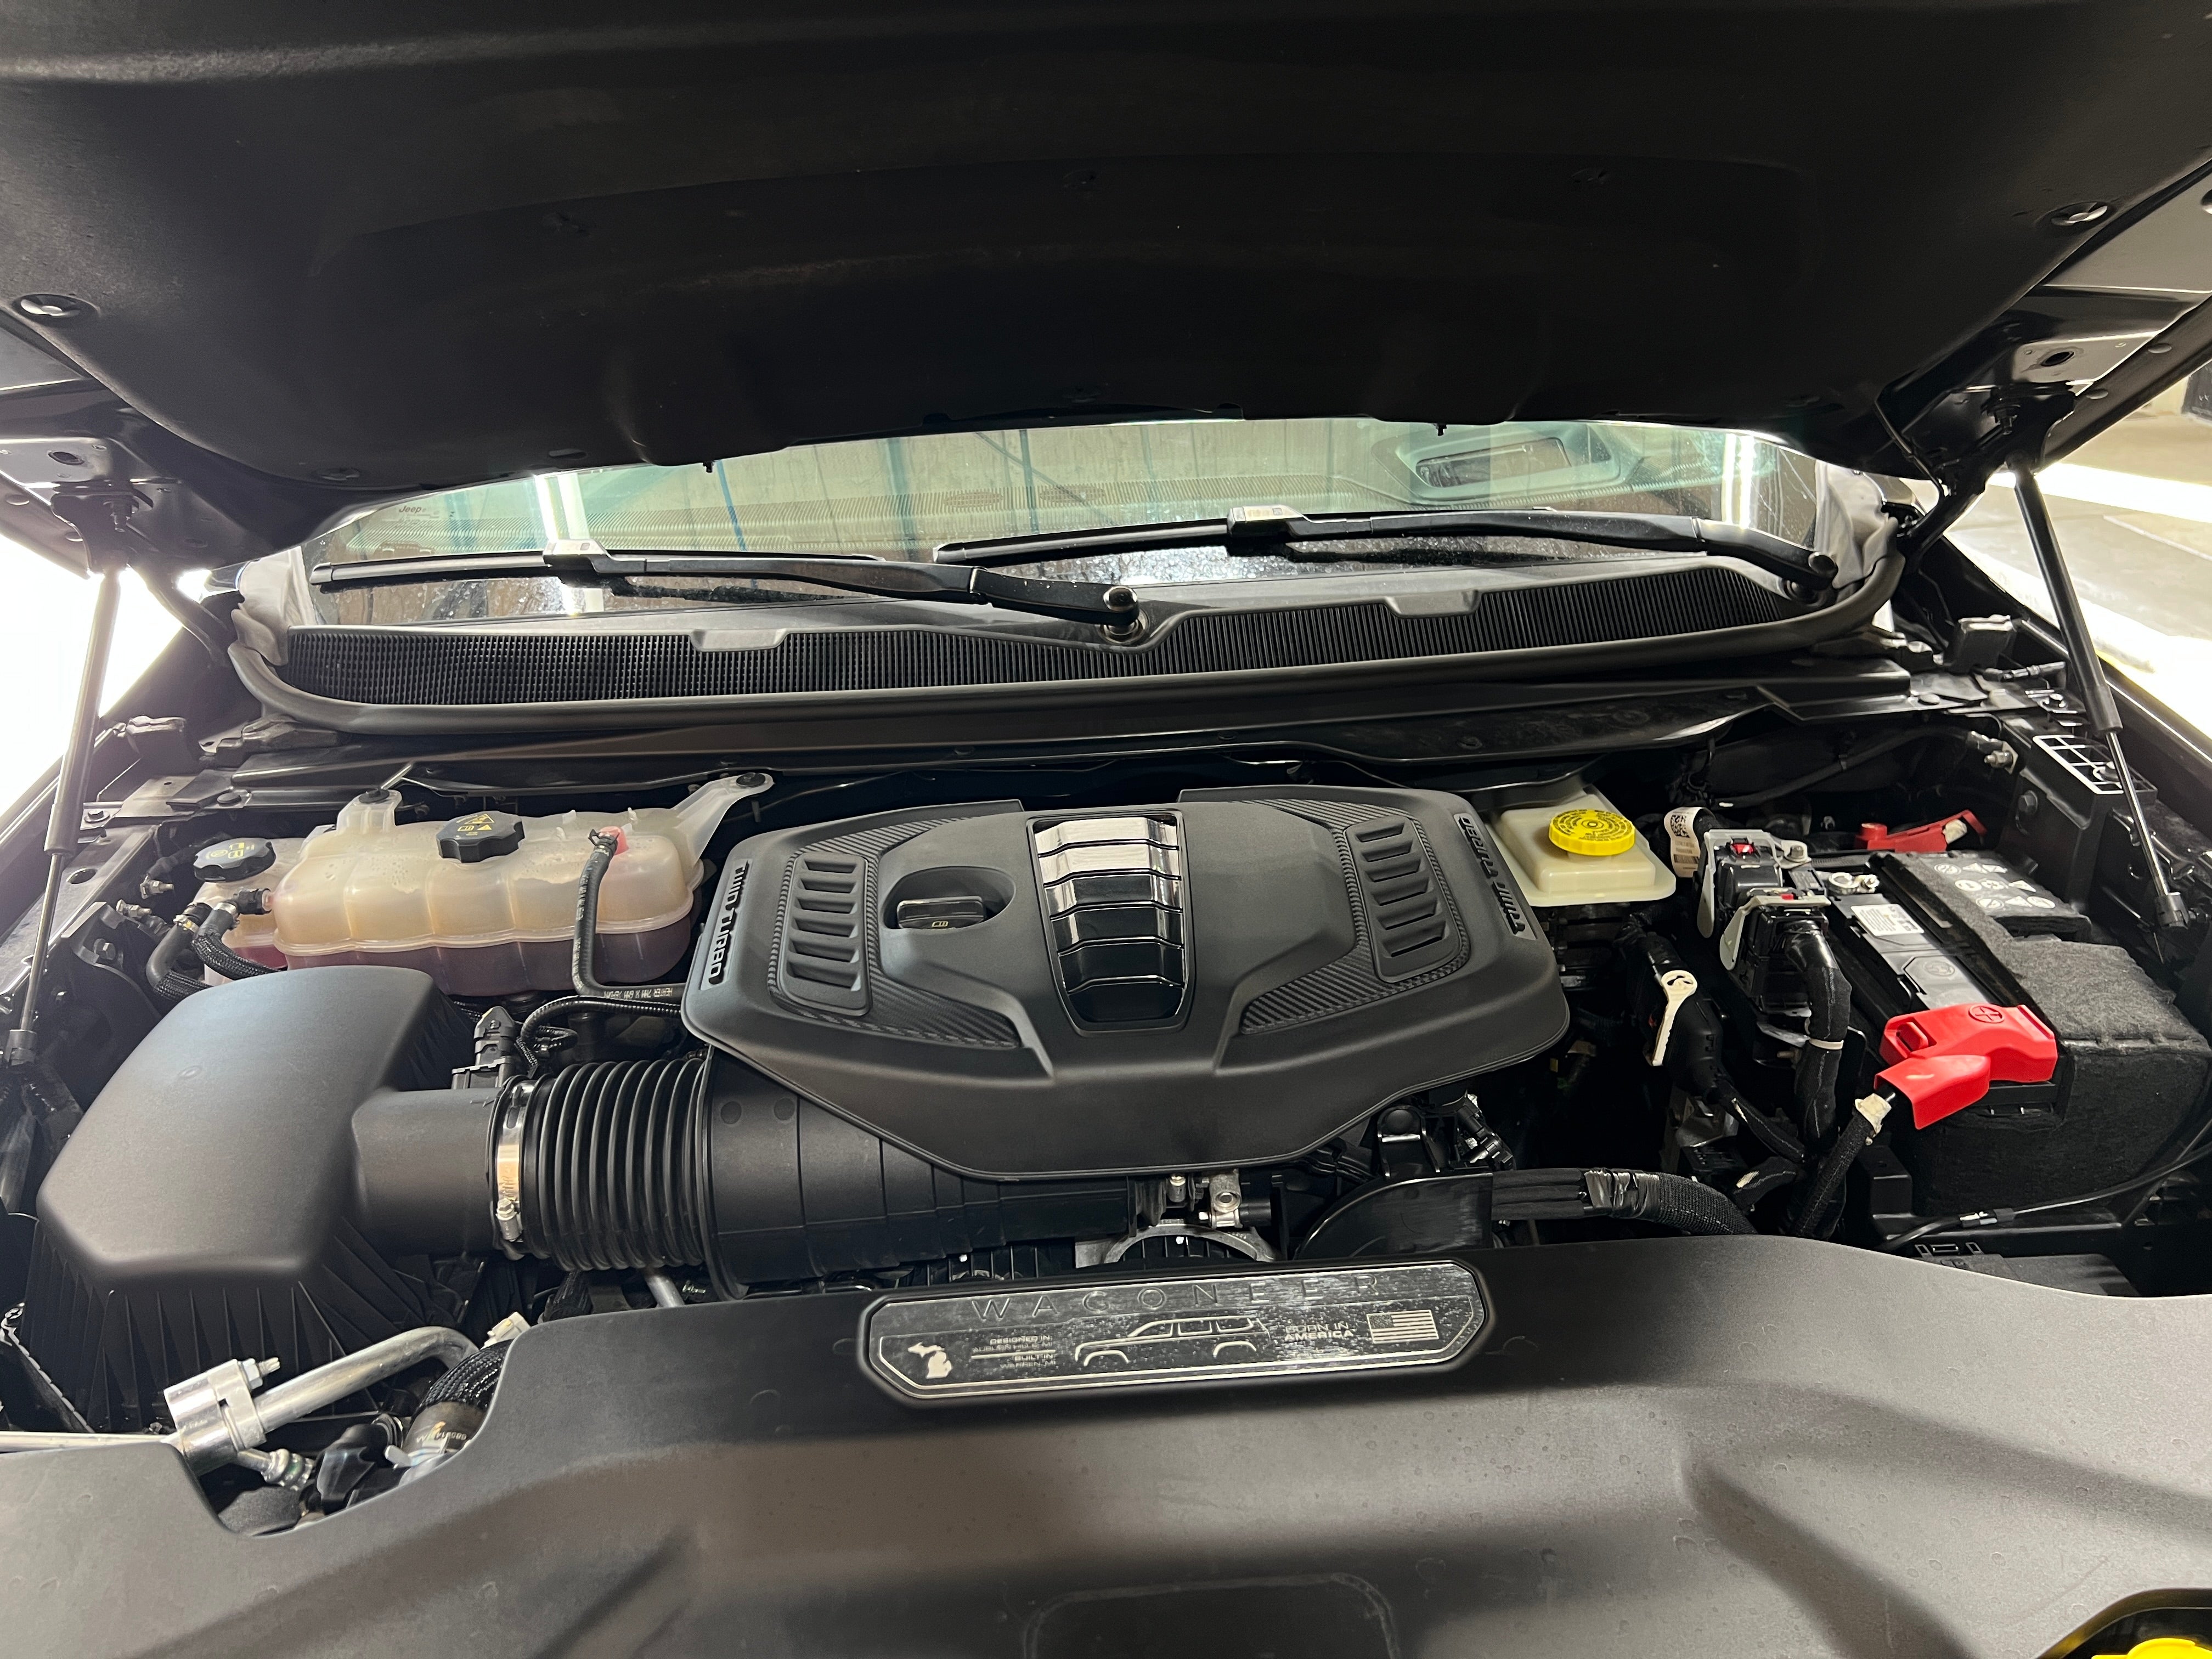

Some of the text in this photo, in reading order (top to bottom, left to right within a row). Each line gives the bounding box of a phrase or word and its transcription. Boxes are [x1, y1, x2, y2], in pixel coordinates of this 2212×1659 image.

[1458, 816, 1526, 935] TWIN TURBO
[708, 860, 749, 985] TWIN TURBO
[971, 1274, 1379, 1321] WAGONEER
[1285, 1322, 1349, 1334] BORN IN
[990, 1335, 1038, 1345] DESIGNED
[1284, 1330, 1354, 1342] AMERICA
[1014, 1353, 1040, 1362] BUILT
